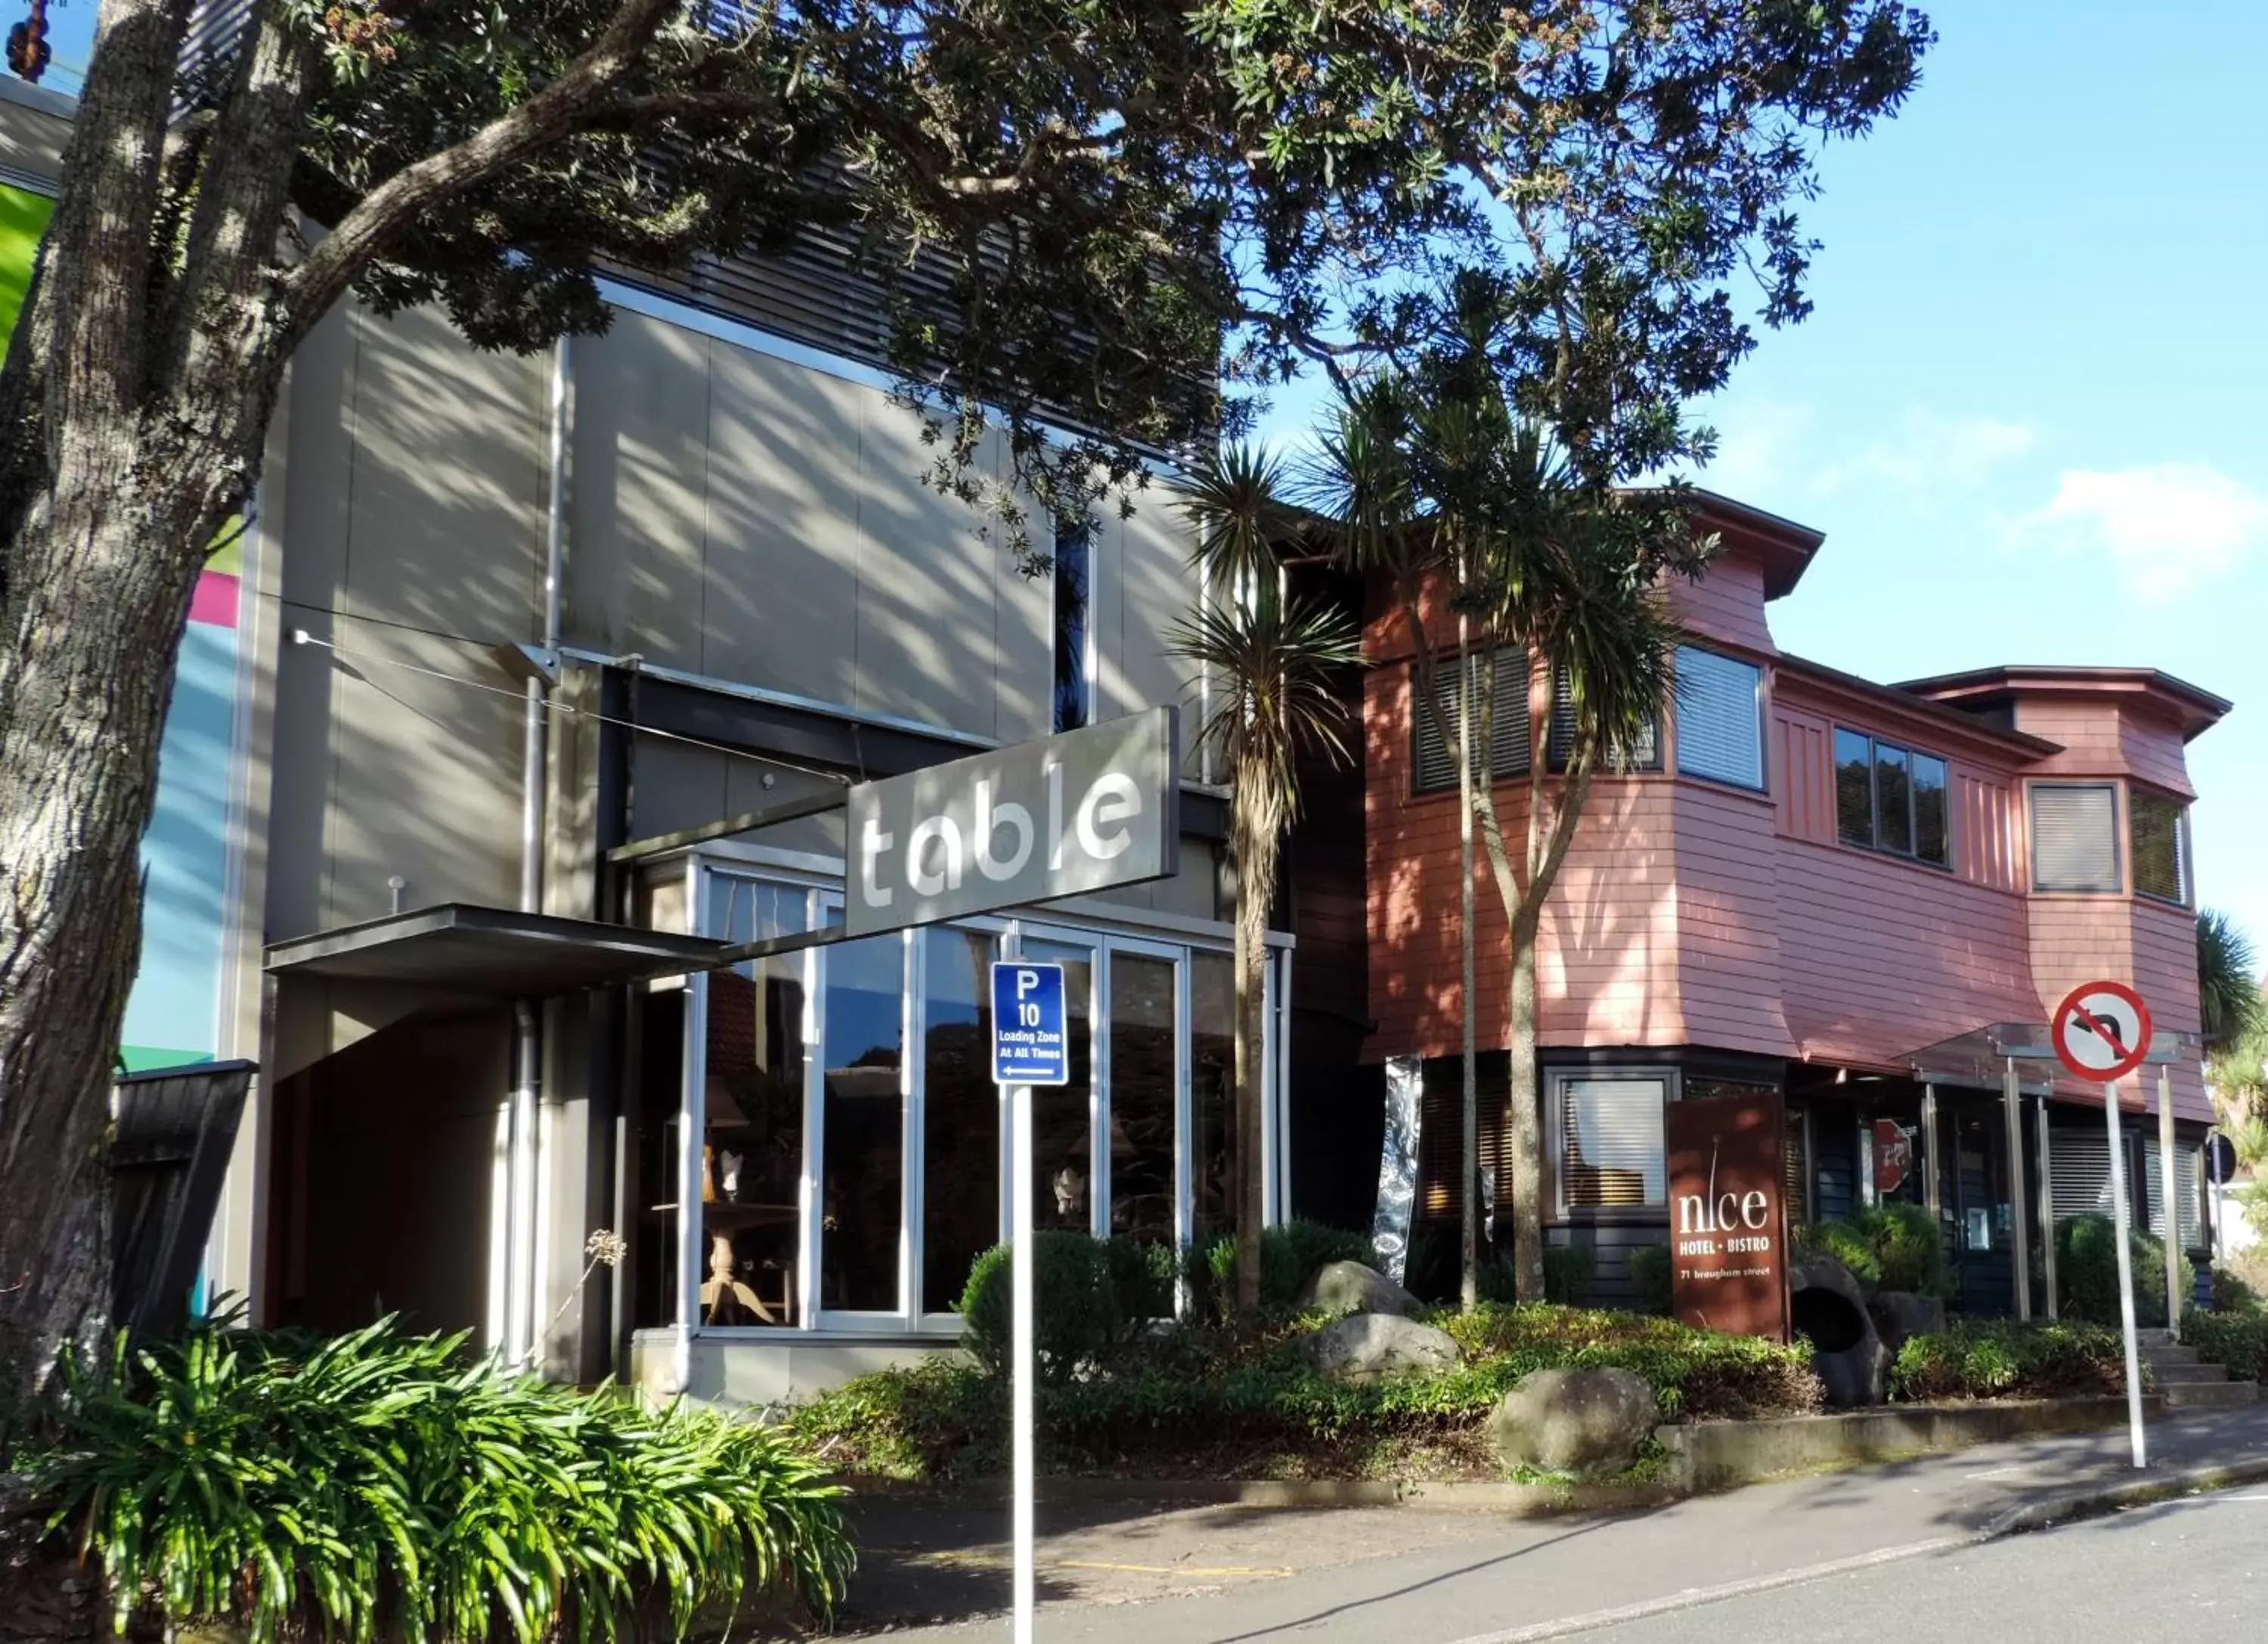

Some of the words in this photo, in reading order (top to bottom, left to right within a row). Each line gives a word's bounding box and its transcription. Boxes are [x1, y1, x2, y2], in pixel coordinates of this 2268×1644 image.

[863, 762, 1142, 907] table
[1017, 969, 1040, 1000] P
[1018, 1003, 1040, 1028] 10
[999, 1030, 1035, 1044] Loading
[1036, 1031, 1061, 1043] Zone
[1000, 1047, 1012, 1058] At
[1014, 1047, 1029, 1058] All
[1031, 1047, 1061, 1059] Times
[1678, 1149, 1768, 1234] nice
[1680, 1239, 1715, 1256] HOTEL
[1727, 1236, 1770, 1254] BISTRO
[1681, 1270, 1690, 1280] 71
[1694, 1267, 1741, 1281] brougham
[1743, 1267, 1771, 1277] street
